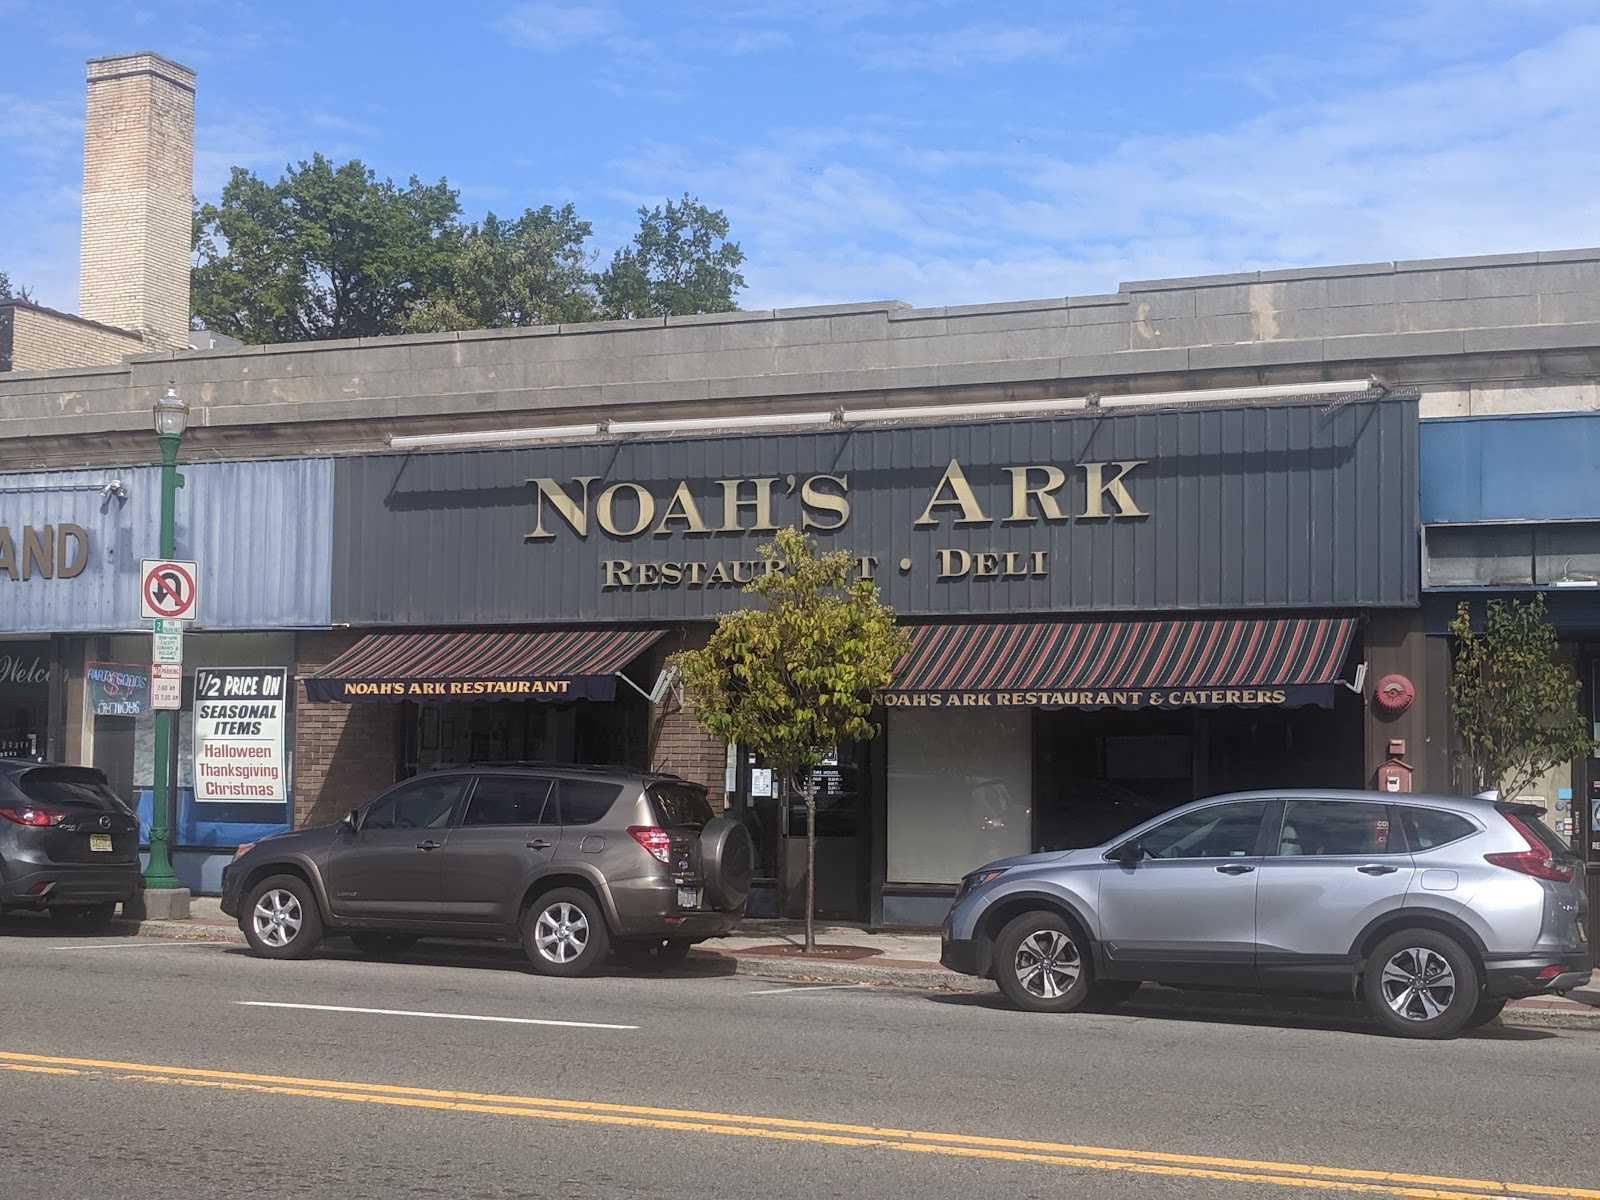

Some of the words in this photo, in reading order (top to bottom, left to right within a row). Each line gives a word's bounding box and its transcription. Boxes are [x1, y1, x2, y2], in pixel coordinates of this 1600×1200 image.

[524, 473, 850, 538] NOAH'S
[914, 458, 1150, 524] ARK
[601, 556, 878, 587] RESTAURT
[936, 549, 1048, 578] DELI
[223, 675, 259, 697] PRICE
[262, 674, 281, 696] ON
[344, 682, 405, 695] NOAH'S
[408, 682, 446, 695] ARK
[450, 680, 571, 694] RESTAURANT
[946, 692, 992, 707] ARK
[997, 691, 1143, 706] RESTAURANT
[1149, 691, 1165, 705] &
[1168, 690, 1287, 704] CATERERS
[199, 704, 277, 719] SEASONAL
[213, 721, 262, 736] ITEMS
[204, 743, 272, 758] Halloween
[199, 762, 279, 779] Thanksgiving
[205, 781, 274, 796] Christmas
